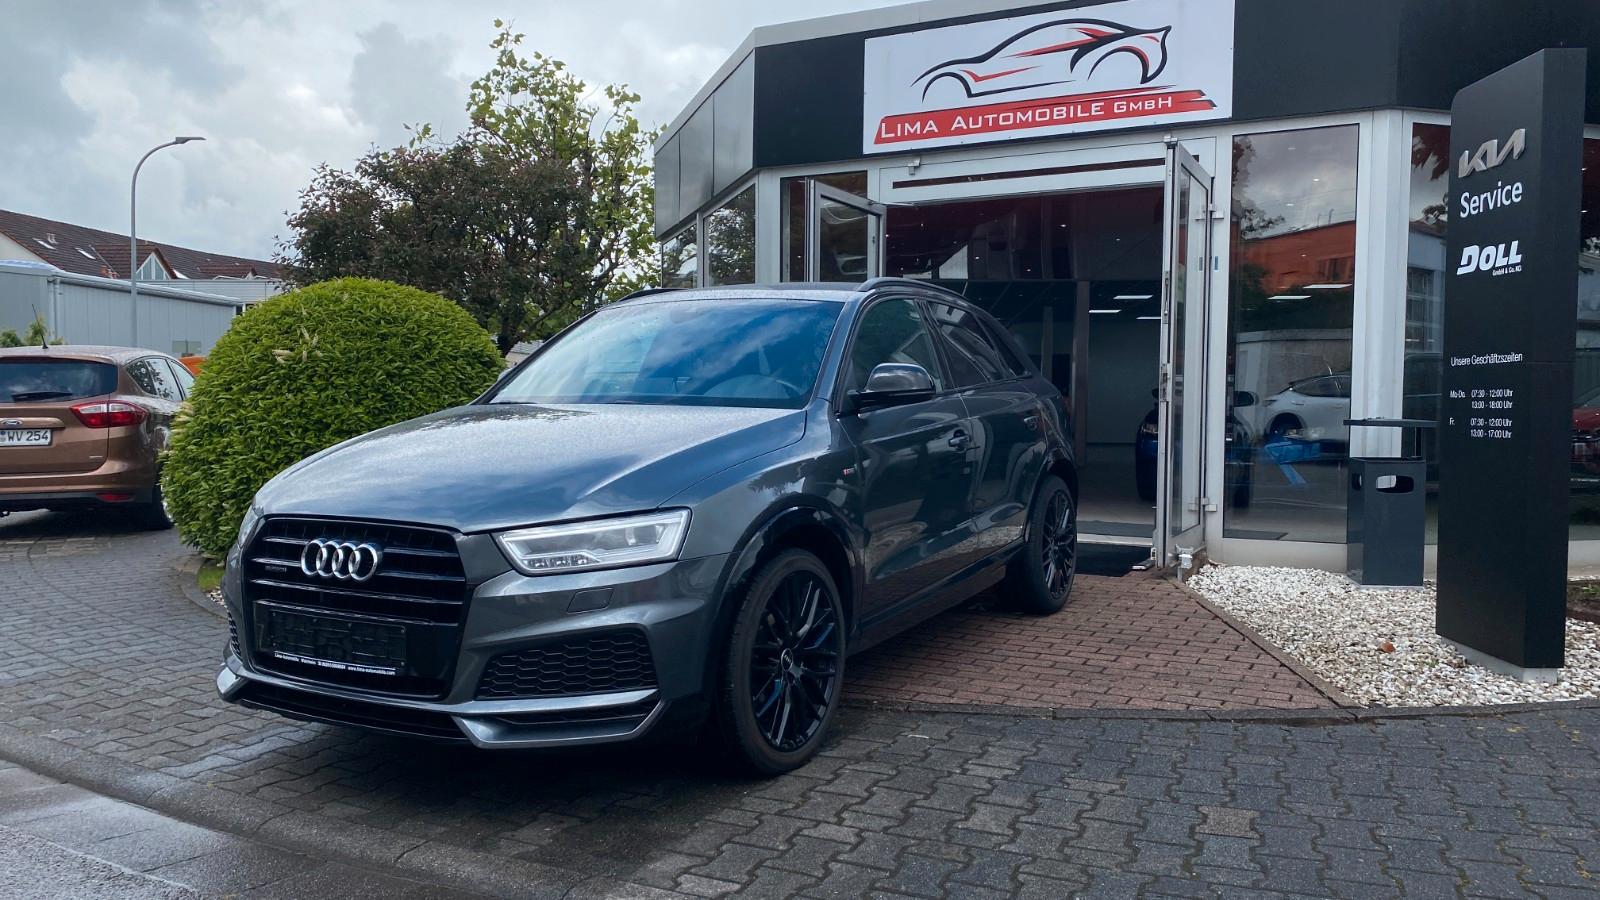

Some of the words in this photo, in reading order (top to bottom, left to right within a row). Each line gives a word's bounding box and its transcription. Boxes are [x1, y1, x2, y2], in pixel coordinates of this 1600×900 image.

[1460, 180, 1523, 219] Service
[1456, 240, 1523, 276] DOLL
[1492, 267, 1504, 276] GmbH
[1450, 356, 1471, 367] Unsere
[1471, 389, 1485, 398] 07:30
[1489, 389, 1503, 398] 12:00
[1503, 388, 1513, 397] Uhr
[1471, 400, 1485, 409] 13:00
[1503, 400, 1513, 409] Uhr
[1470, 417, 1484, 426] 07:30
[1489, 418, 1502, 427] 12:00
[1503, 418, 1513, 427] Uhr
[7, 430, 24, 442] WV
[26, 430, 49, 442] 254
[1470, 429, 1484, 438] 13:00
[1488, 429, 1502, 438] 17:00
[1502, 430, 1512, 439] Uhr
